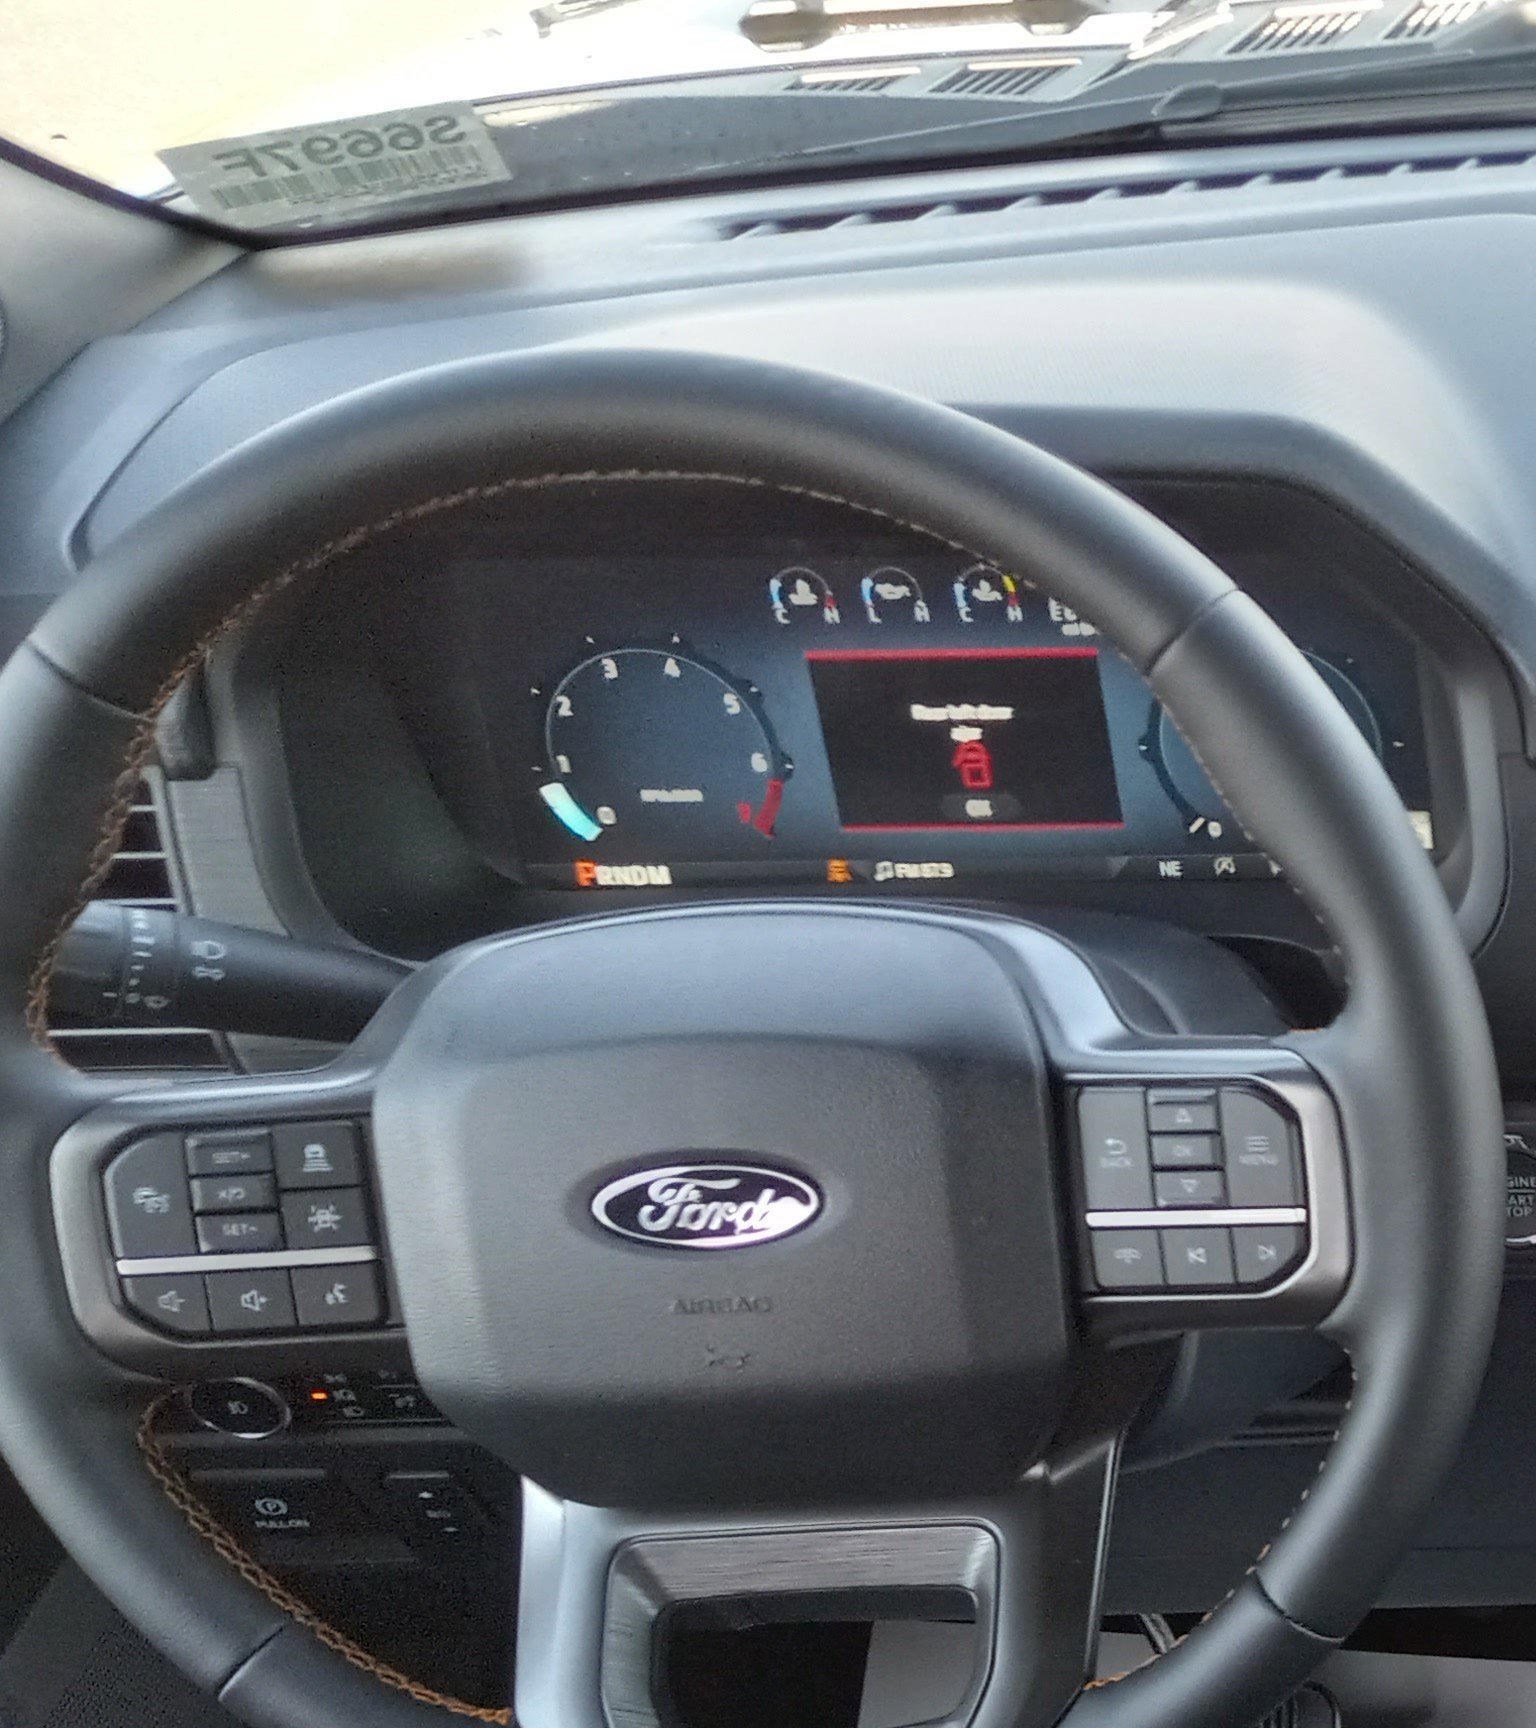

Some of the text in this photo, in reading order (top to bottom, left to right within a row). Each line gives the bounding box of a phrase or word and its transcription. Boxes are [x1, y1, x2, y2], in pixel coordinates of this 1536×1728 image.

[601, 658, 619, 680] 3
[663, 658, 681, 678] 4
[556, 694, 575, 718] 2
[723, 692, 741, 715] 5
[751, 752, 768, 773] 6
[1159, 860, 1184, 878] NE
[637, 1177, 780, 1235] Ford
[1506, 1206, 1533, 1218] TOP
